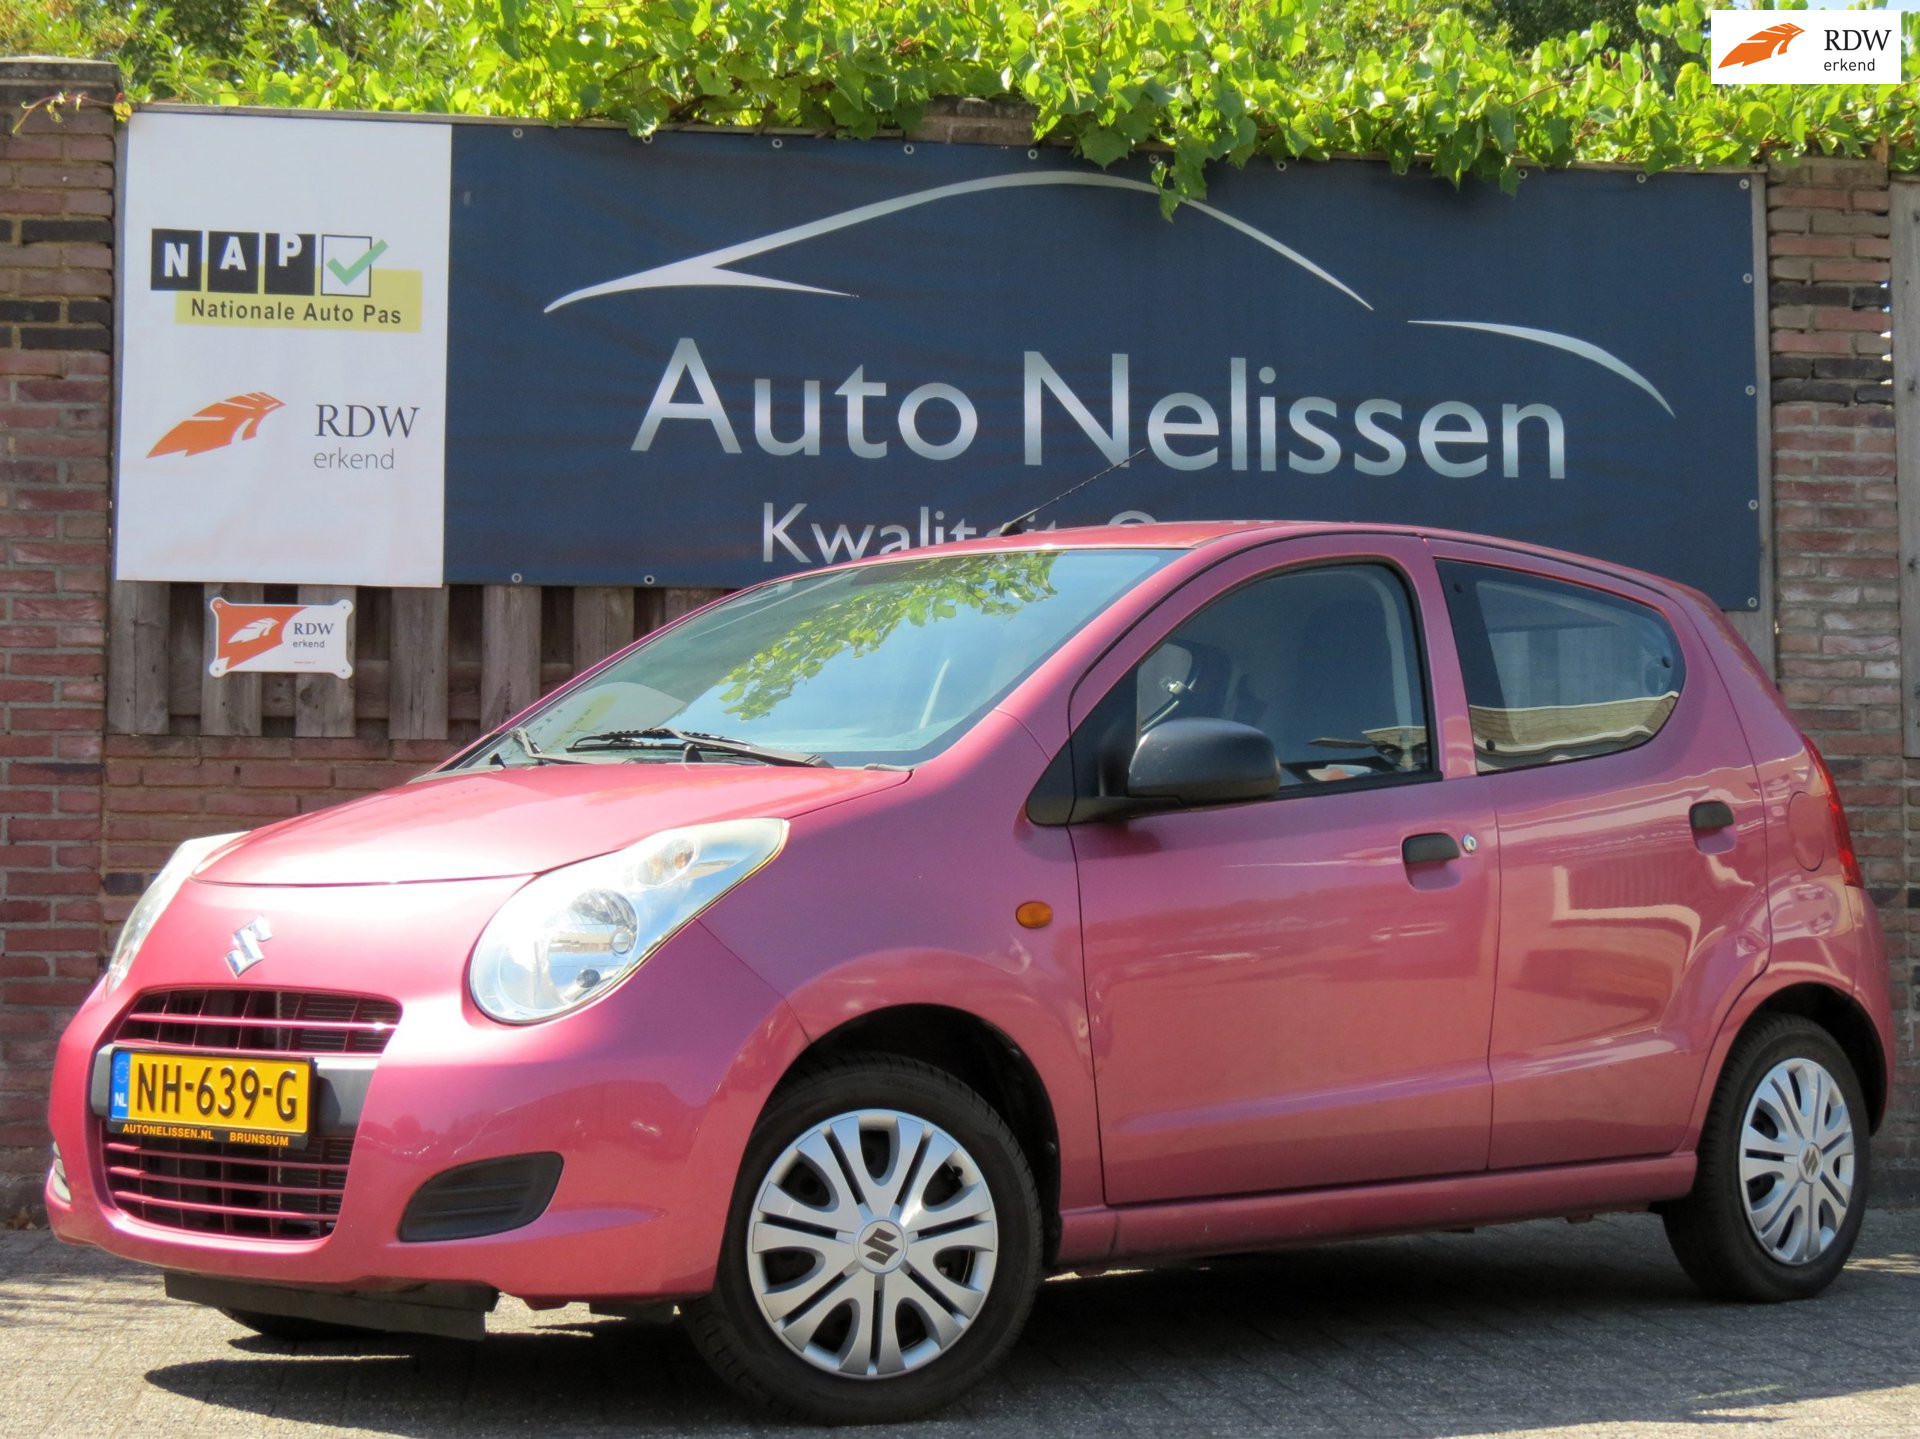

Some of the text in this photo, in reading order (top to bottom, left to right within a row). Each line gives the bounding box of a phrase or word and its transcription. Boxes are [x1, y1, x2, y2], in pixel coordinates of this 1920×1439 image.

[163, 233, 303, 278] NAP
[191, 298, 402, 325] Nationale Auto Pas
[314, 403, 421, 439] RDW
[630, 337, 1566, 479] Auto Nelissen
[313, 446, 395, 470] erkend
[762, 501, 1057, 564] Kwalit
[292, 639, 326, 649] erkend
[293, 622, 335, 636] RDW
[114, 1061, 297, 1123] NL NH-639-G
[122, 1123, 290, 1147] AUTONELISSEN.NL BRUNSSUM
